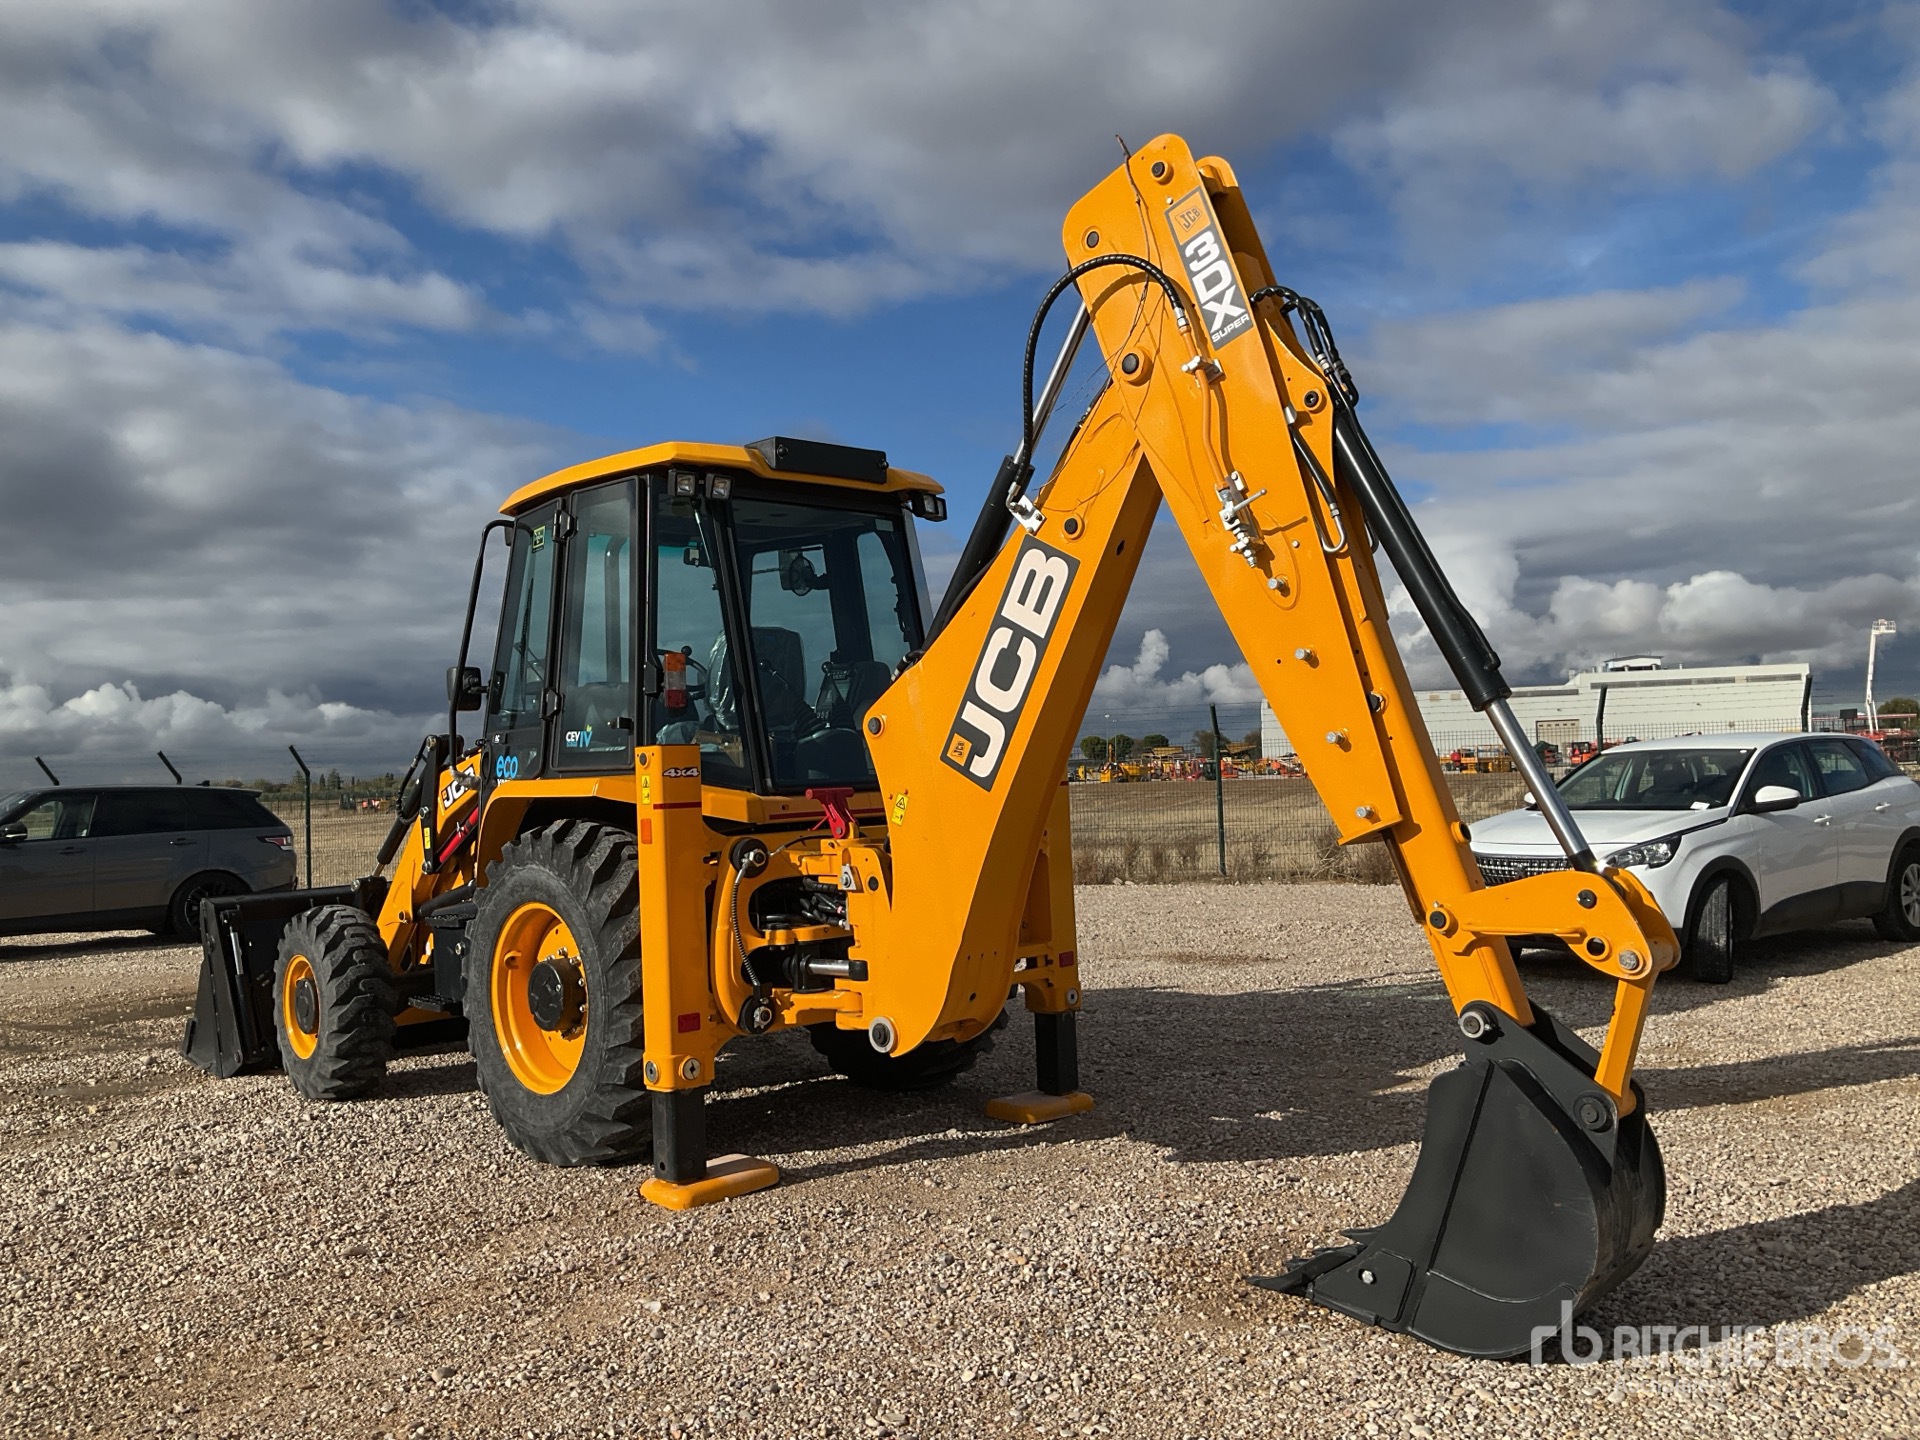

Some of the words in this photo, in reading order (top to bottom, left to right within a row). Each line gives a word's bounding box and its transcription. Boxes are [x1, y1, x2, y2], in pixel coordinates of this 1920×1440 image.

[1179, 207, 1201, 229] JCB
[1184, 230, 1246, 334] 3DX
[1211, 315, 1250, 343] SUPER
[960, 547, 1069, 778] JCB
[496, 755, 518, 778] eco
